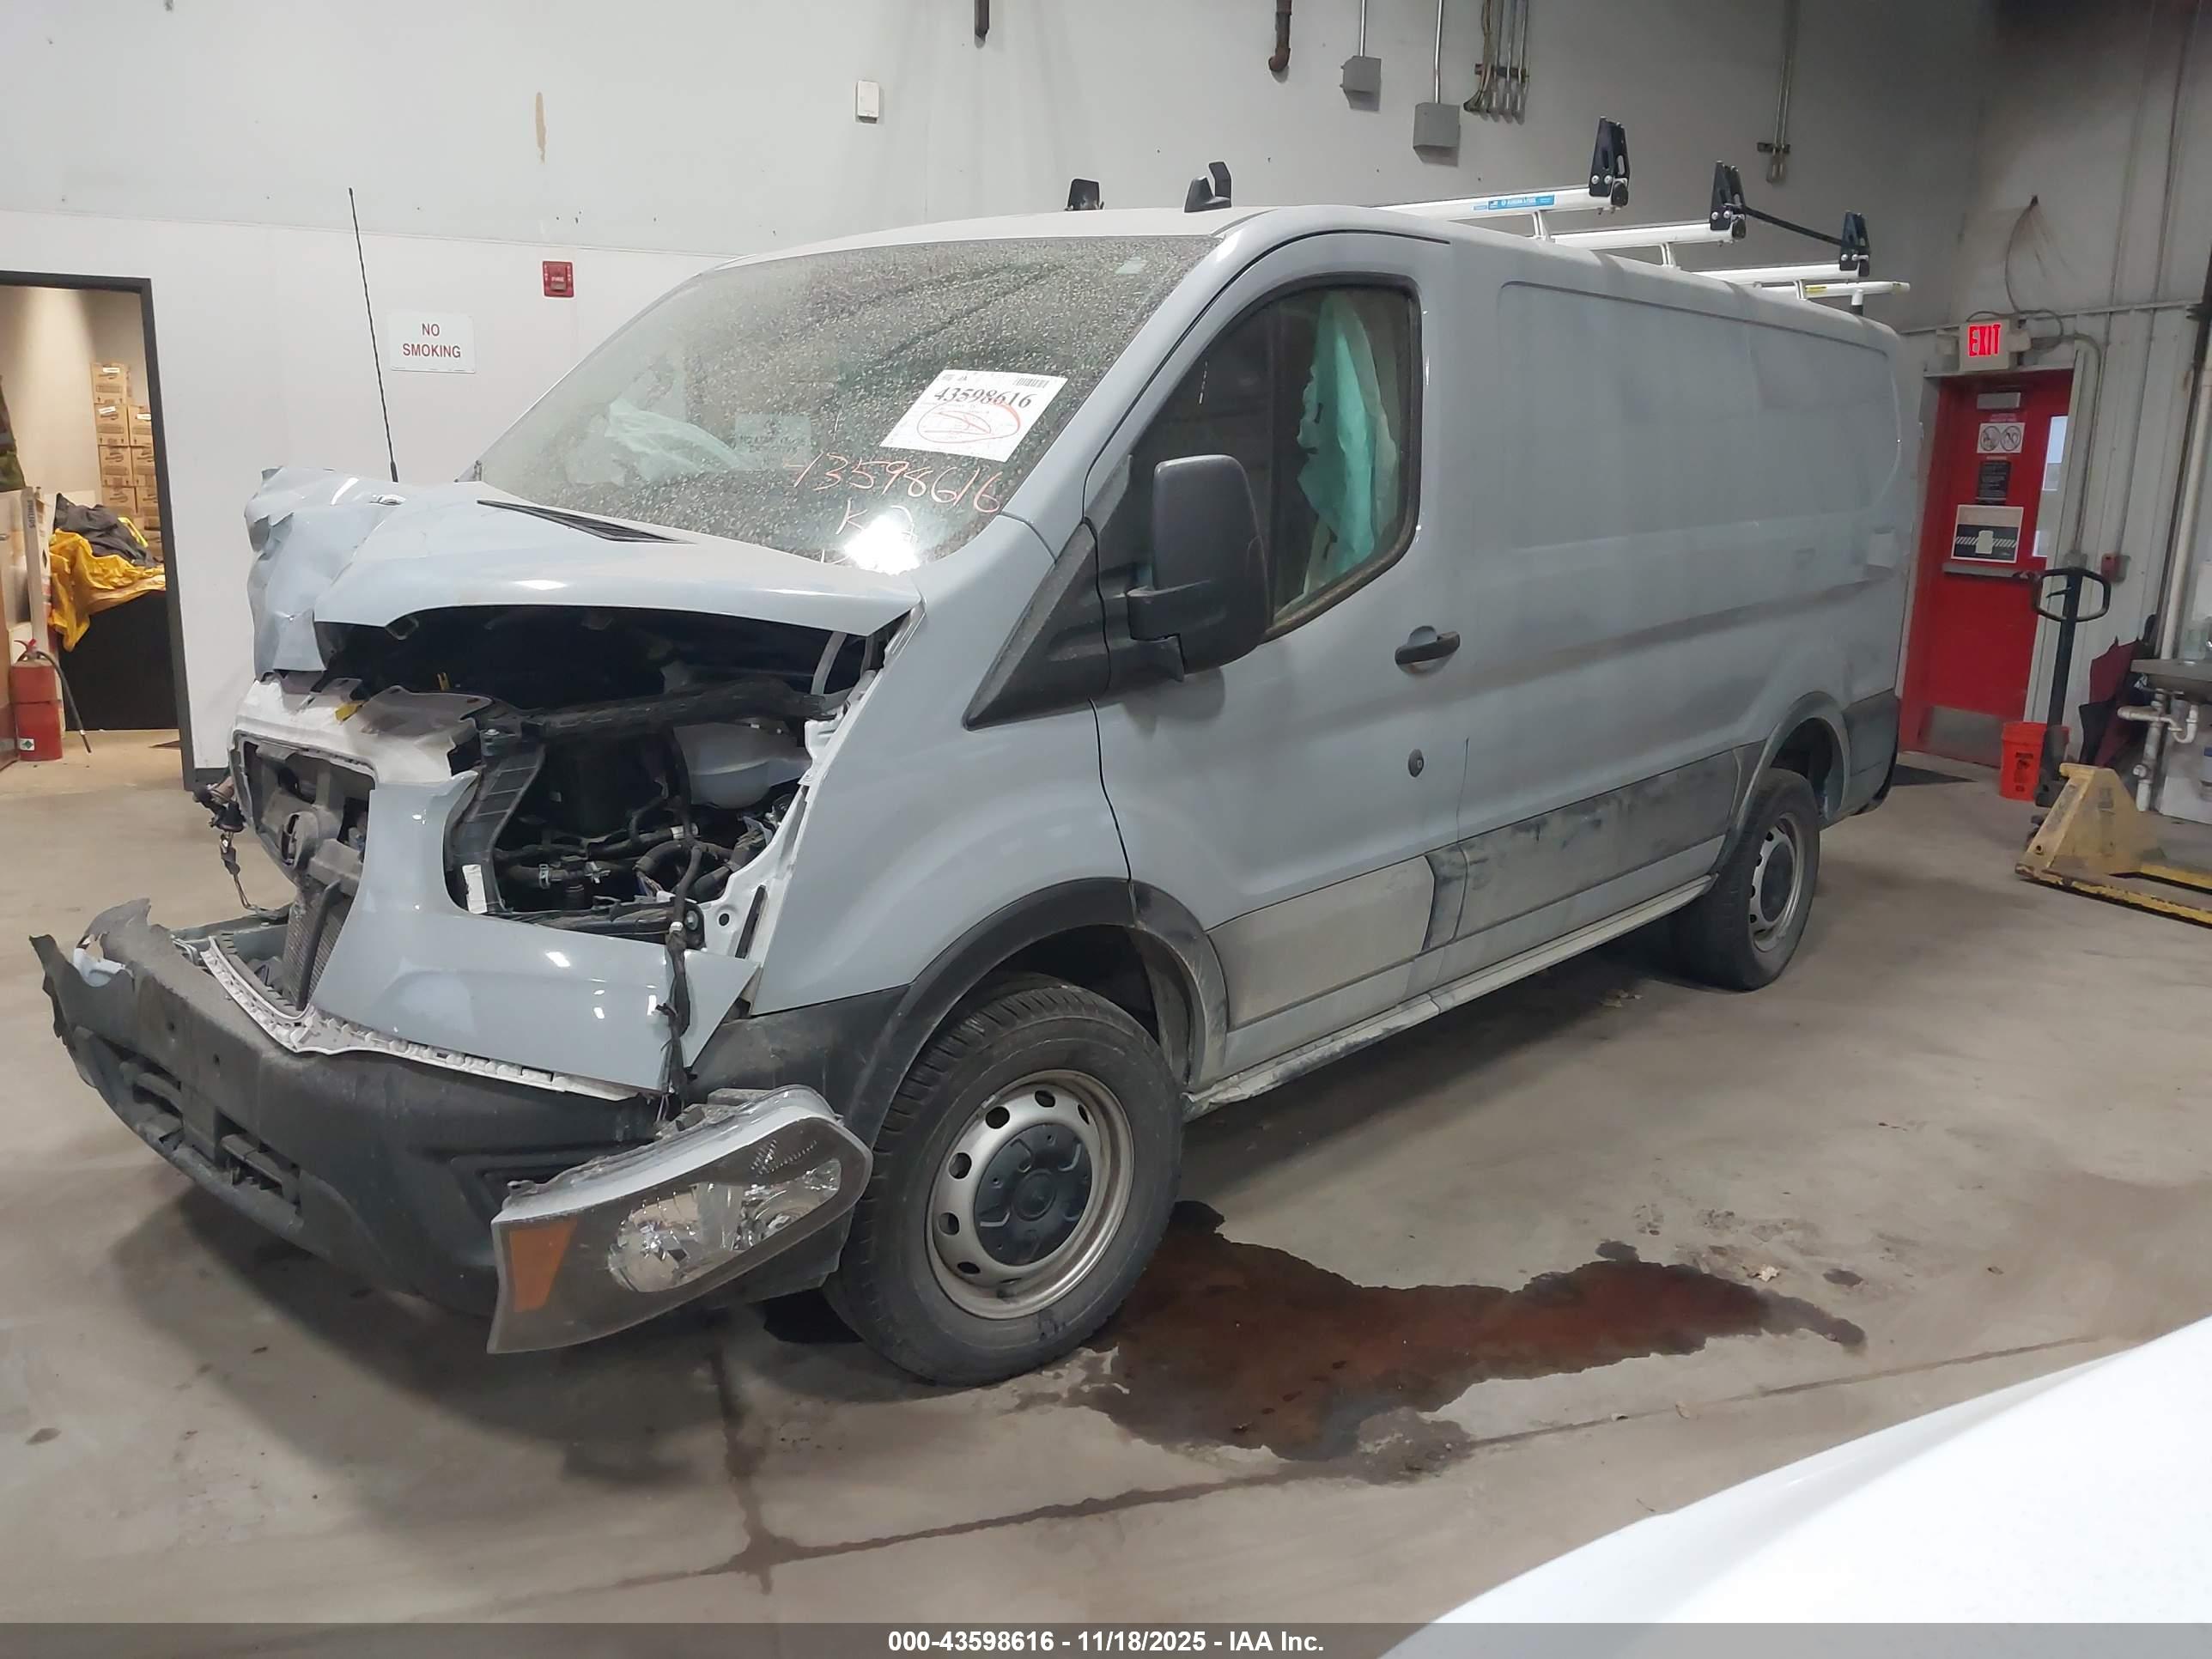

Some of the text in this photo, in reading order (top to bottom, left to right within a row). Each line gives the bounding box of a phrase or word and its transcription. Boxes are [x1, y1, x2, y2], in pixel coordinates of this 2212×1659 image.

[422, 323, 441, 337] NO
[1969, 324, 2001, 356] EXIT
[403, 343, 461, 358] SMOKING
[933, 386, 1037, 409] 43598616
